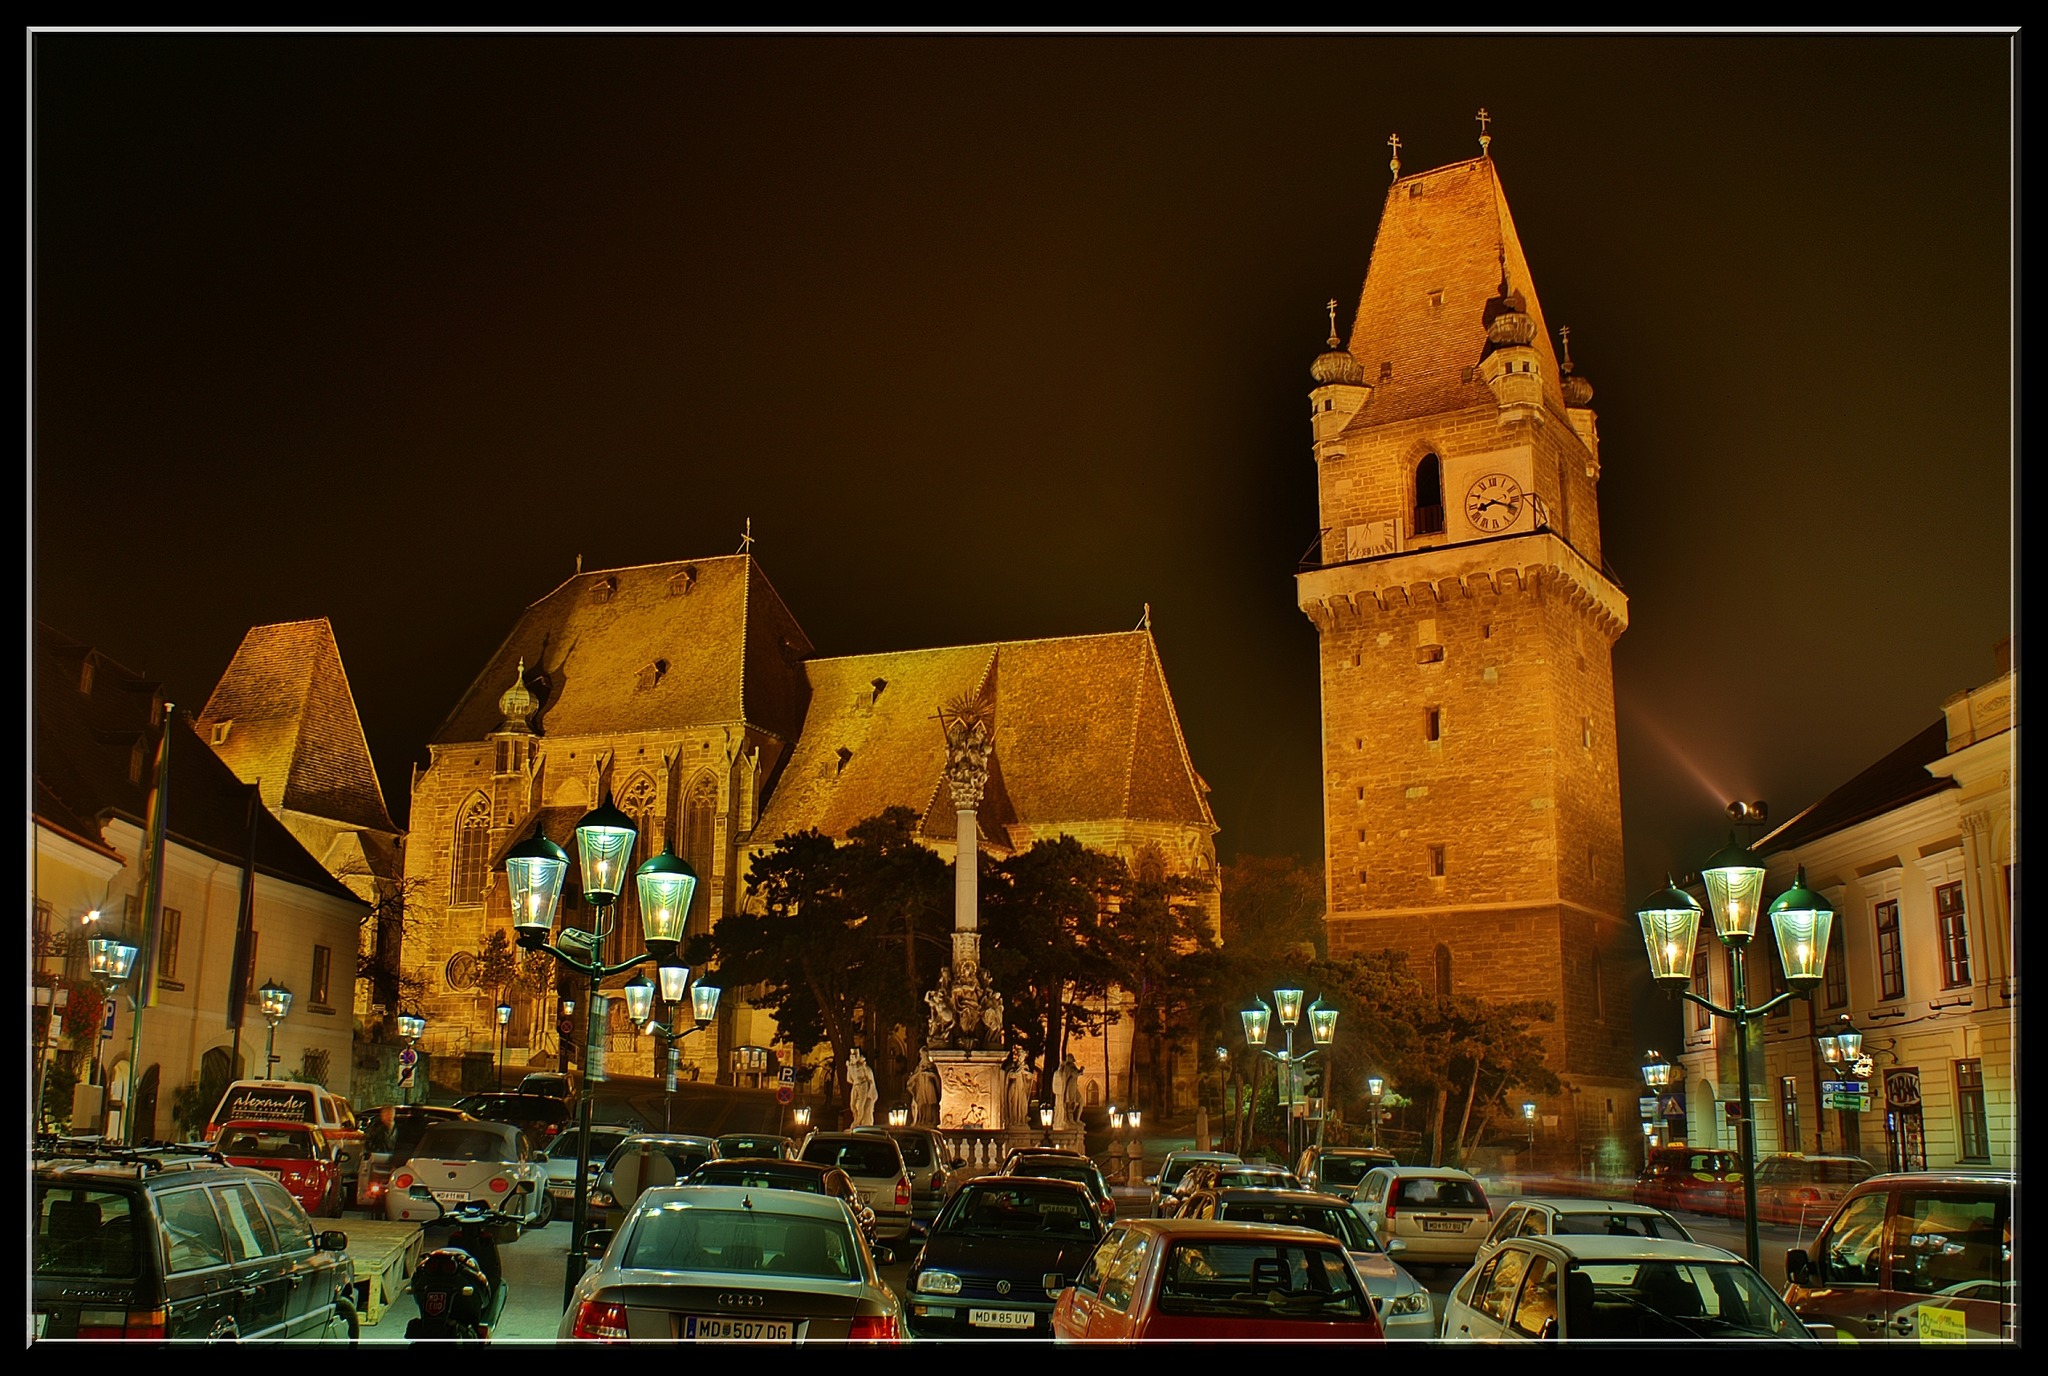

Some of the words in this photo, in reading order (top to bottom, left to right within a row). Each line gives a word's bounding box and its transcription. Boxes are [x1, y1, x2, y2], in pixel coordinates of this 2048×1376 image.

[104, 1002, 115, 1027] P
[782, 1067, 793, 1081] P
[1887, 1075, 1921, 1104] TABAK
[233, 1091, 307, 1109] alexander
[976, 1311, 990, 1322] MD
[999, 1312, 1012, 1323] 85
[1015, 1313, 1029, 1324] UV
[699, 1320, 720, 1338] MD
[733, 1322, 764, 1340] 507
[767, 1324, 787, 1340] DG
